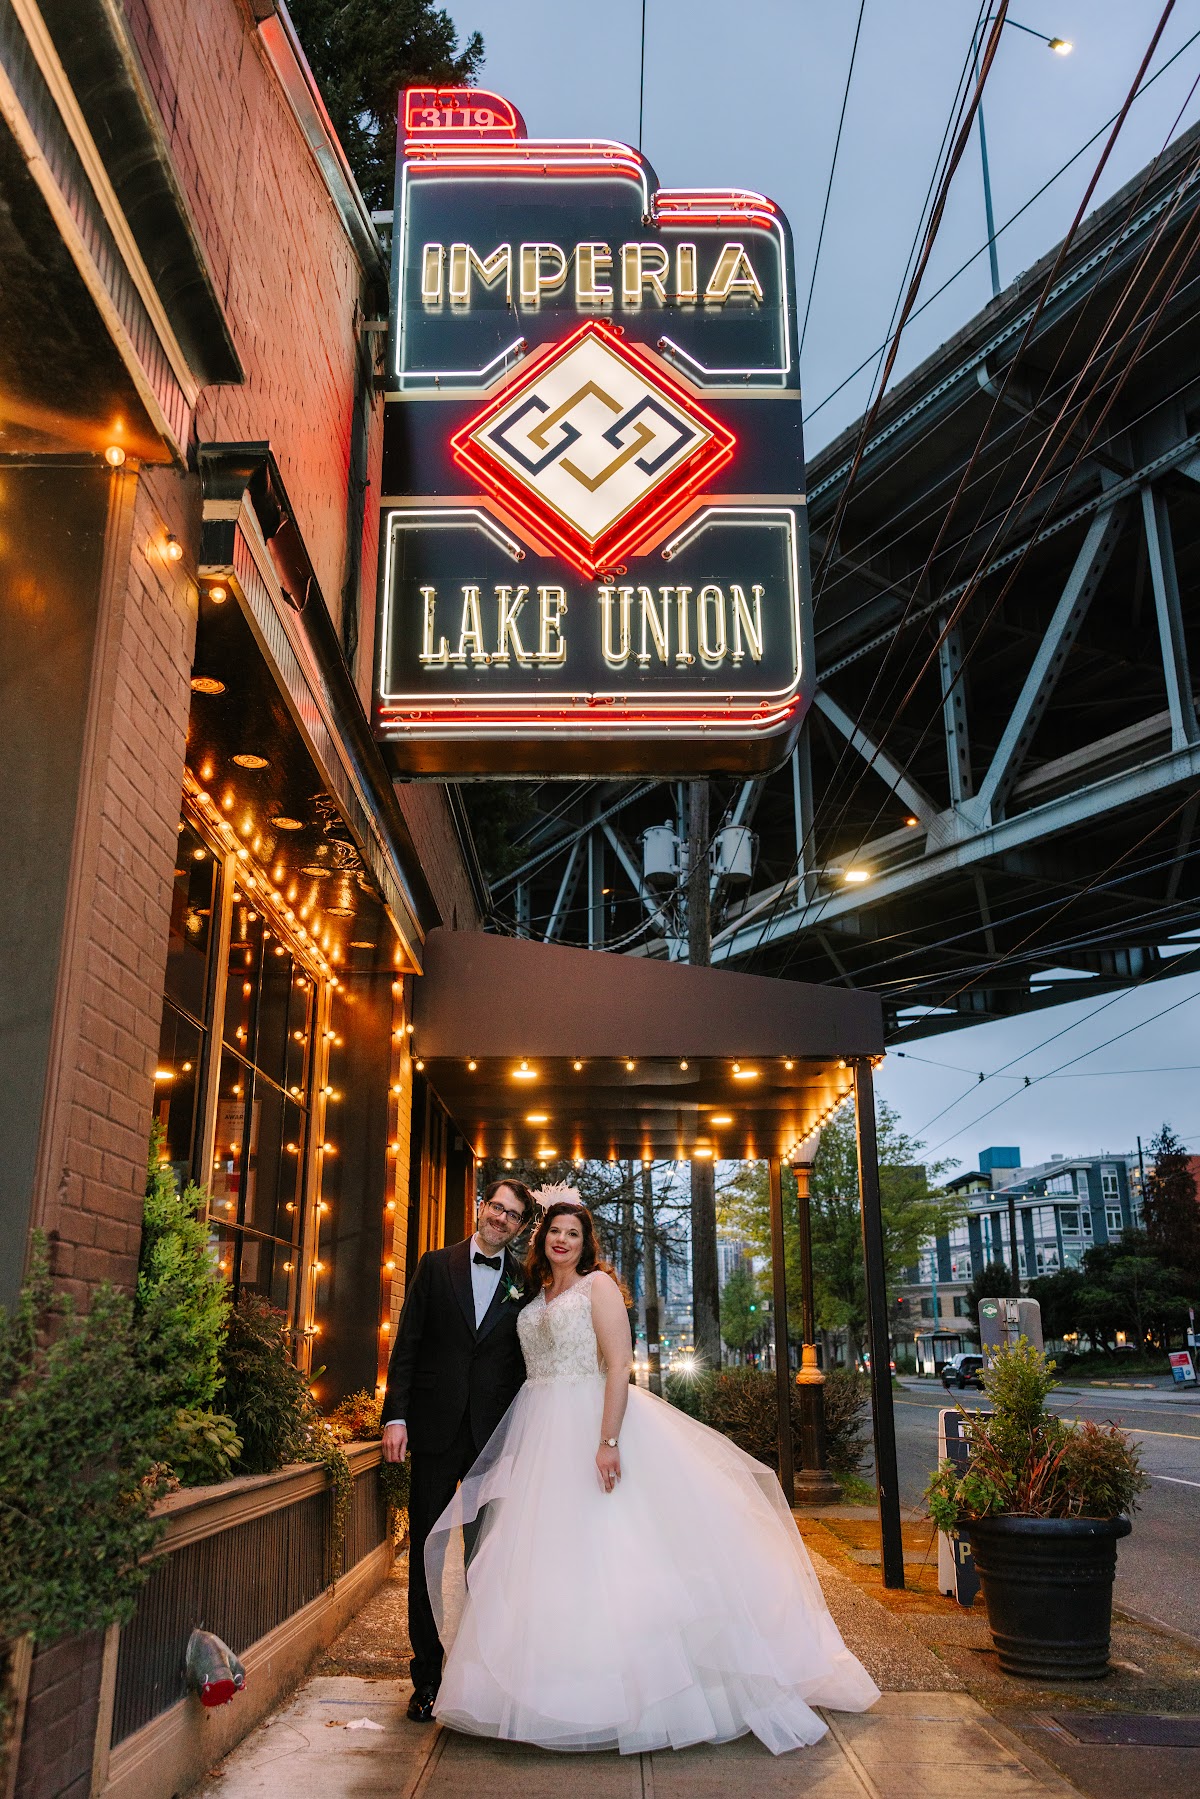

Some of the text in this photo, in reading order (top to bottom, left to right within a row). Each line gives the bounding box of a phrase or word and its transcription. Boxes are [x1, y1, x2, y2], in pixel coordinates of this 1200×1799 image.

[420, 108, 495, 128] 3119
[421, 242, 764, 303] IMPERIA
[418, 584, 766, 663] LAKE UNION
